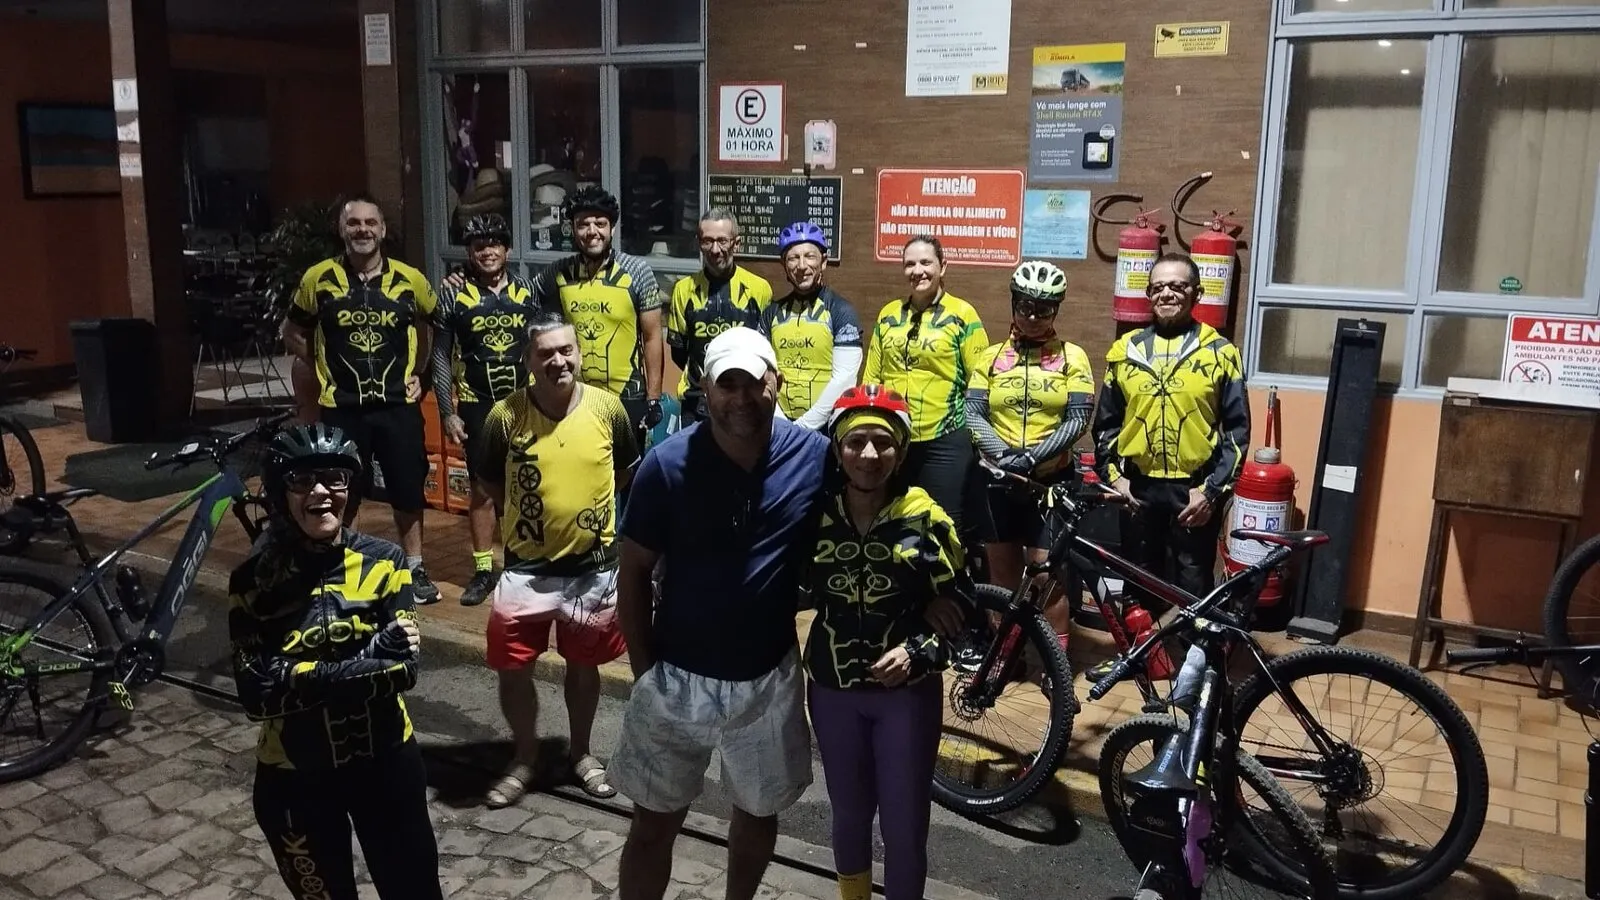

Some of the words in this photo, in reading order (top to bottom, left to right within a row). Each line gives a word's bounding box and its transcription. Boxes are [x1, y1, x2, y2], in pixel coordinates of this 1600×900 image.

[744, 96, 758, 118] E
[1036, 101, 1047, 110] Vá
[1048, 101, 1065, 109] mais
[1067, 100, 1089, 111] longe
[1036, 110, 1053, 119] Shell
[1055, 109, 1081, 119] Rimula
[1083, 109, 1103, 118] RT4X
[727, 126, 773, 138] MÁXIMO
[726, 140, 737, 151] 01
[741, 140, 774, 151] HORA
[922, 175, 977, 195] ATENÇÃO
[891, 204, 907, 217] NÃO
[907, 205, 919, 218] DÊ
[919, 206, 952, 218] ESMOLA
[952, 207, 964, 218] OU
[965, 207, 1006, 220] ALIMENTO
[880, 221, 896, 234] NÃO
[897, 223, 935, 236] ESTIMULE
[935, 225, 942, 236] A
[943, 224, 985, 238] VADIAGEM
[986, 226, 991, 237] E
[992, 225, 1017, 238] VÍCIO
[570, 300, 611, 314] 200K
[337, 309, 397, 327] 200K
[471, 313, 525, 332] 200K
[1527, 321, 1600, 343] ATEN
[779, 337, 814, 350] 200K
[882, 335, 936, 353] 200K
[1515, 344, 1557, 353] PROIBIDA
[1568, 346, 1593, 356] AÇÃO
[1514, 352, 1573, 361] AMBULANTES
[1000, 376, 1059, 393] 200K
[510, 435, 545, 546] 200K
